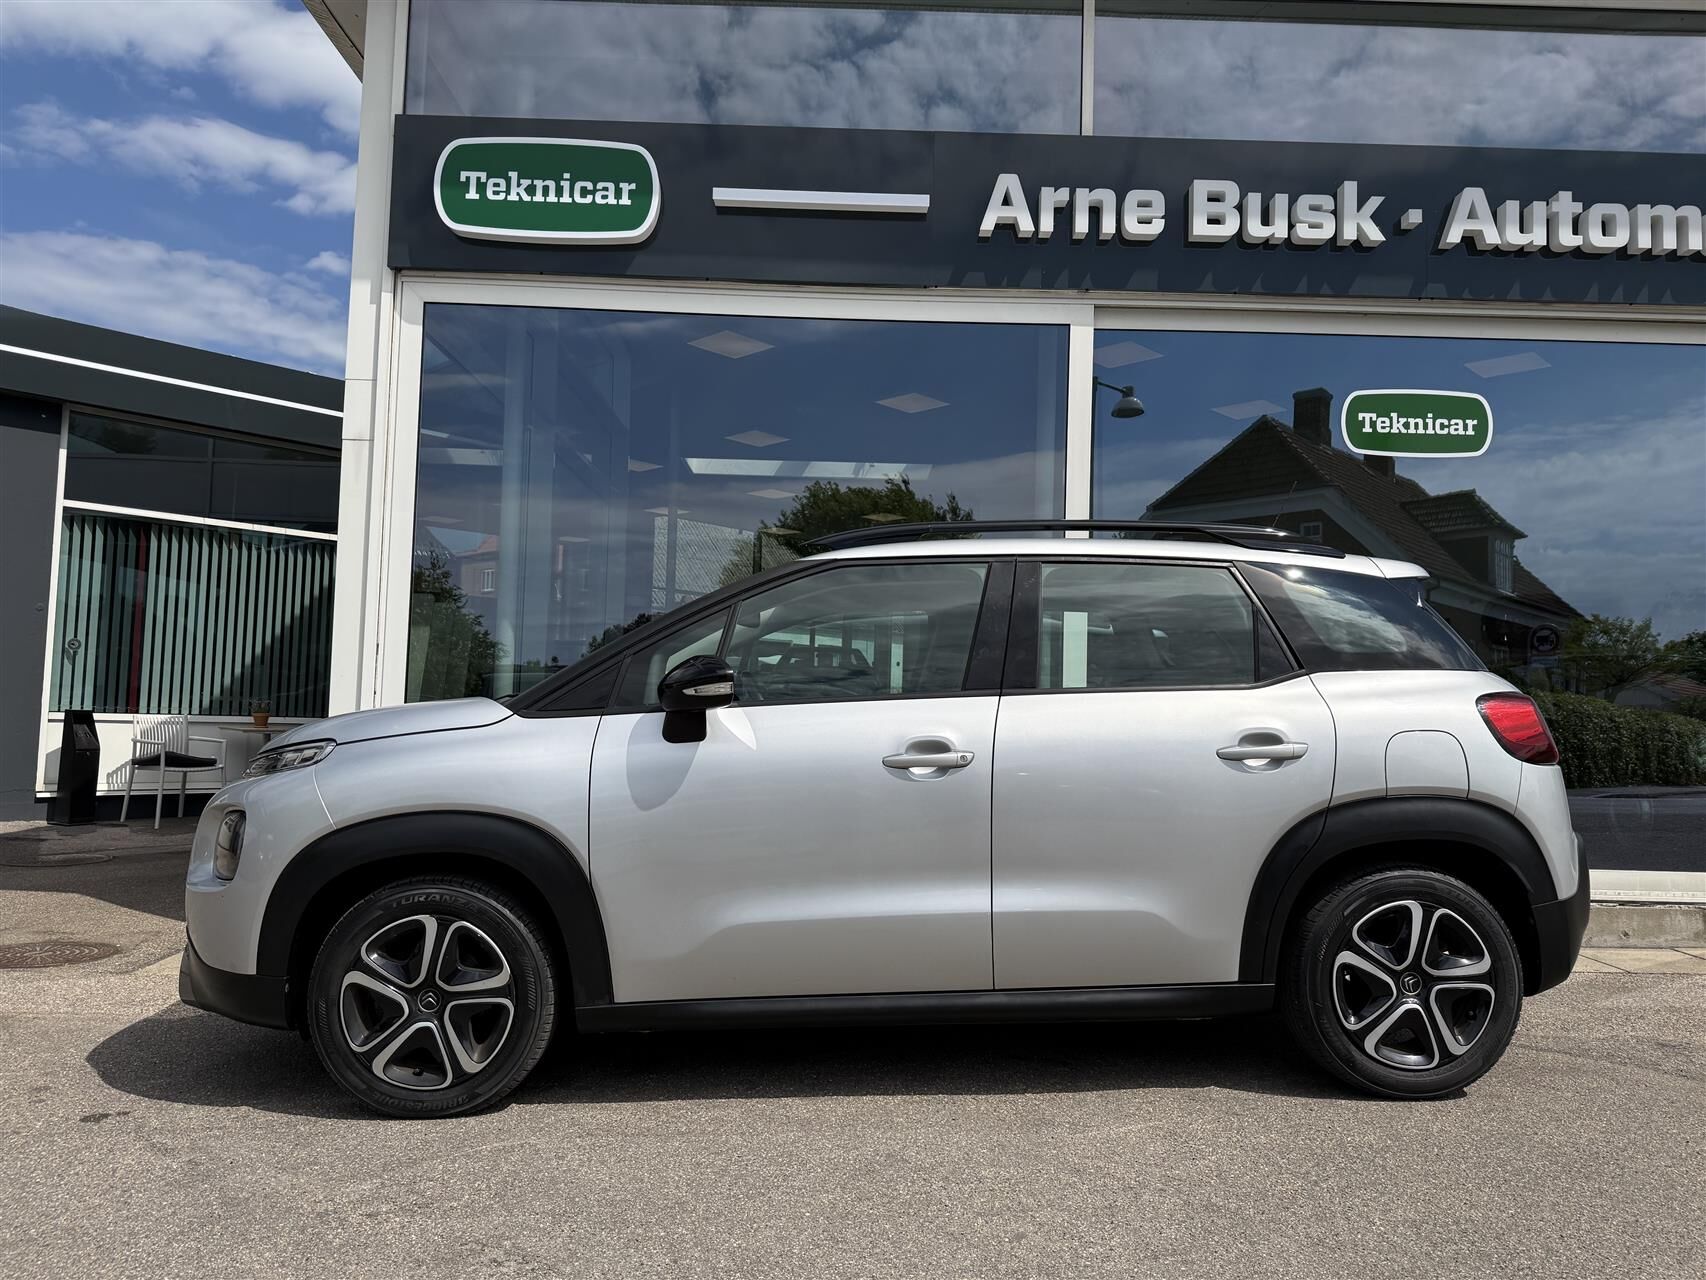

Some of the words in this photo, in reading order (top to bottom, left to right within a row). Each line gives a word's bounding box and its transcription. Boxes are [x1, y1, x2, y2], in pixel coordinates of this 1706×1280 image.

[459, 170, 637, 205] Teknicar
[979, 173, 1166, 241] Arne
[1188, 179, 1386, 247] Busk
[1438, 187, 1706, 256] Autom
[1358, 412, 1478, 436] Teknicar
